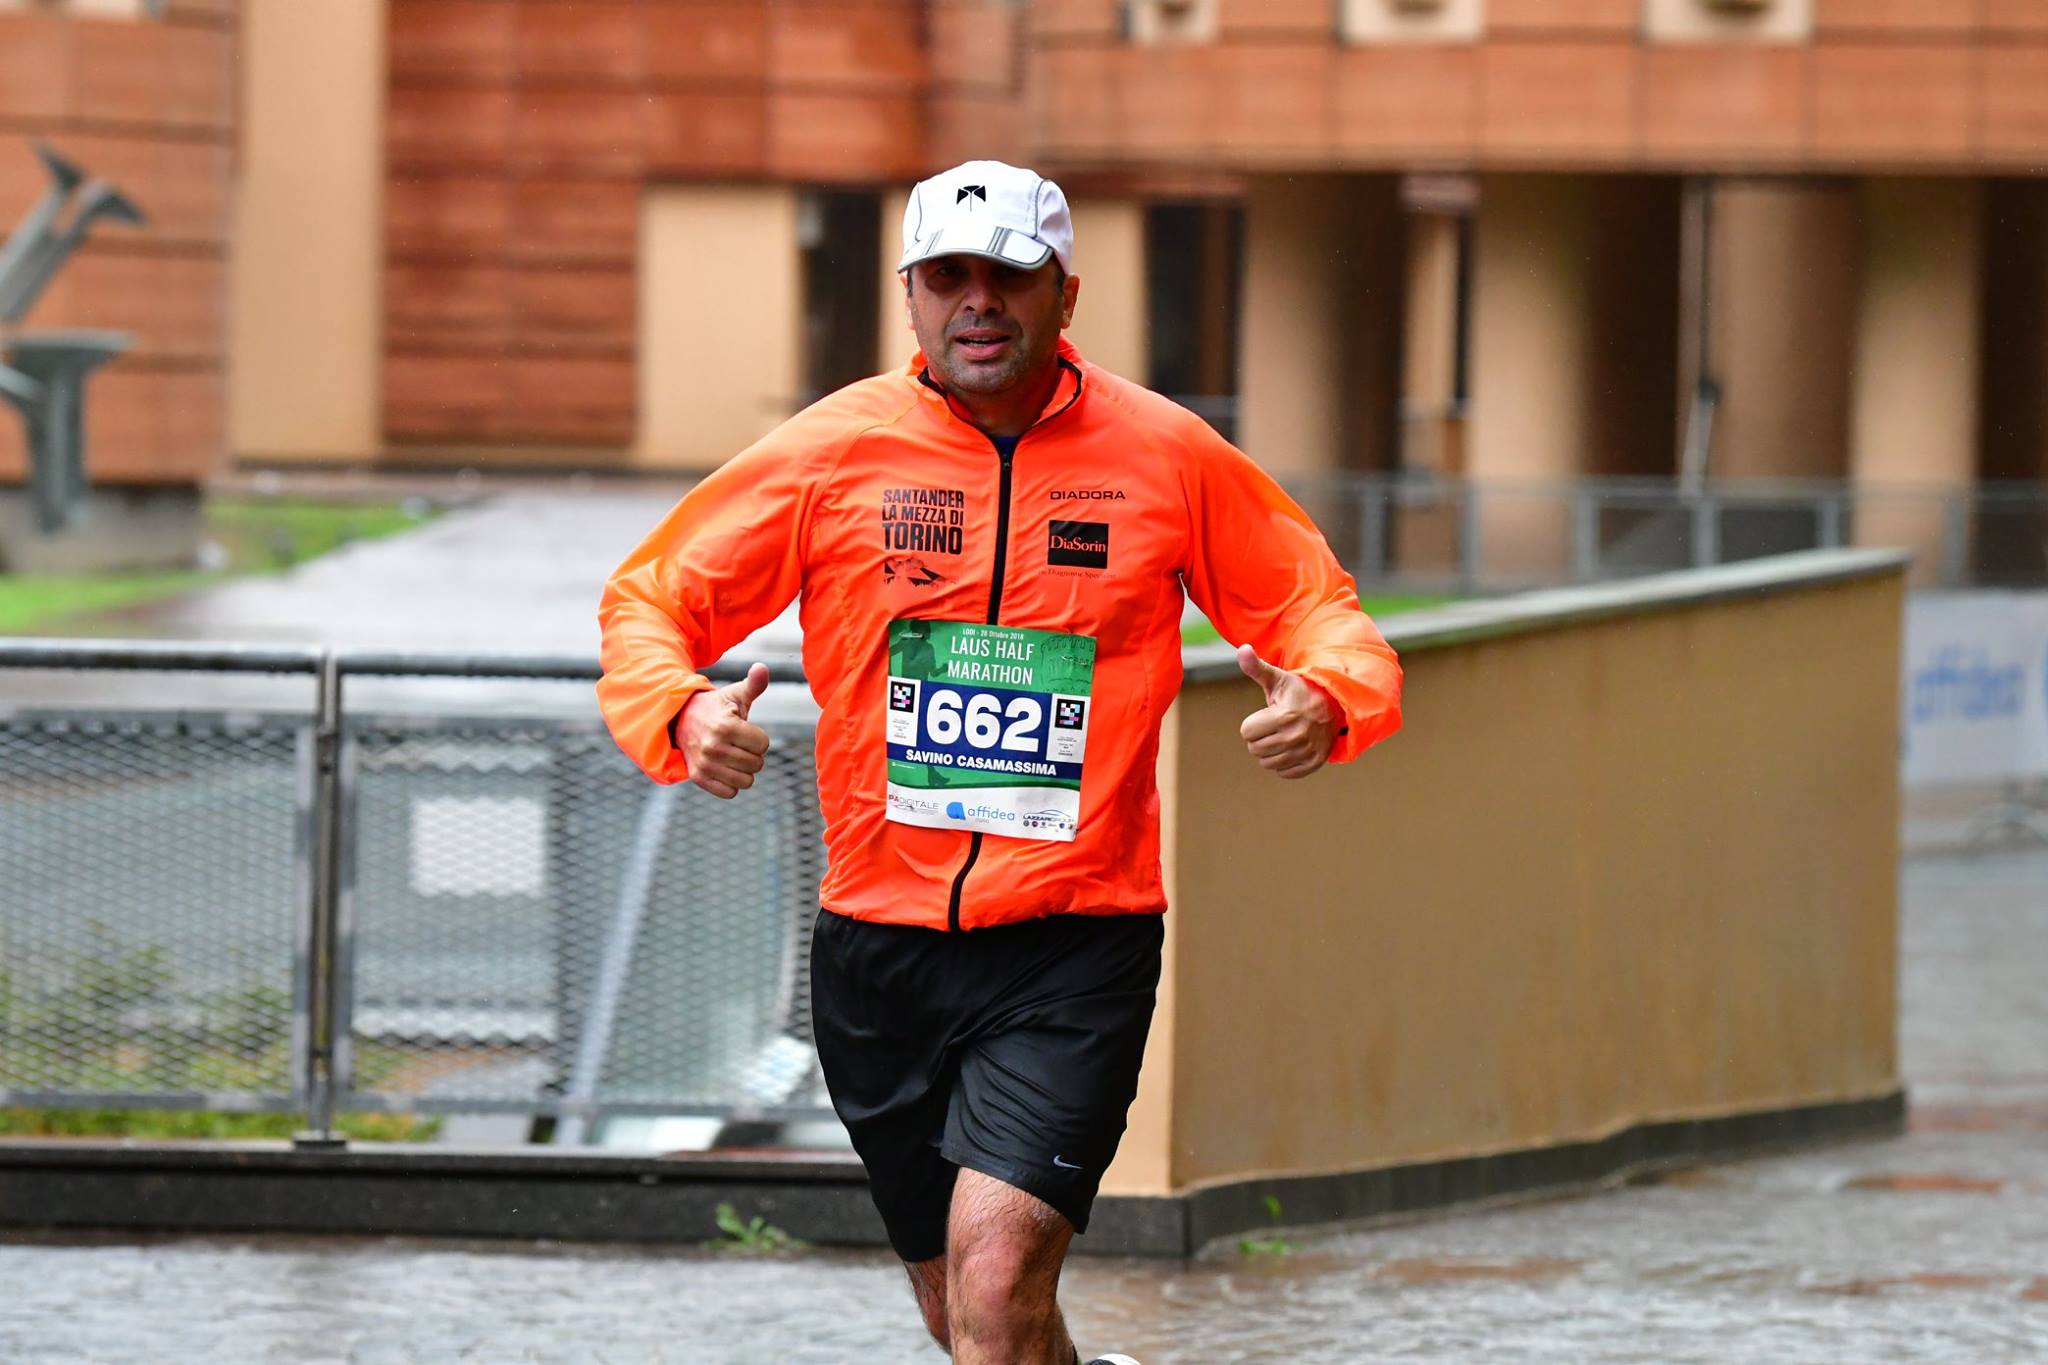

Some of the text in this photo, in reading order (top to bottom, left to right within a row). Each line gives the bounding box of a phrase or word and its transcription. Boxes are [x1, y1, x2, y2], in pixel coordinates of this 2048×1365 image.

[883, 489, 965, 508] SANTANDER
[1049, 490, 1126, 500] DIADORA
[882, 505, 964, 526] LA MEZZA DI
[882, 522, 963, 555] TORINO
[1050, 535, 1107, 553] DiaSorin
[951, 636, 1035, 661] LAUS HALF
[947, 659, 1033, 686] MARATHON
[926, 688, 1042, 753] 662
[905, 749, 953, 766] SAVINO
[956, 756, 1057, 776] CASAMASSIMA
[968, 805, 1015, 821] affidea
